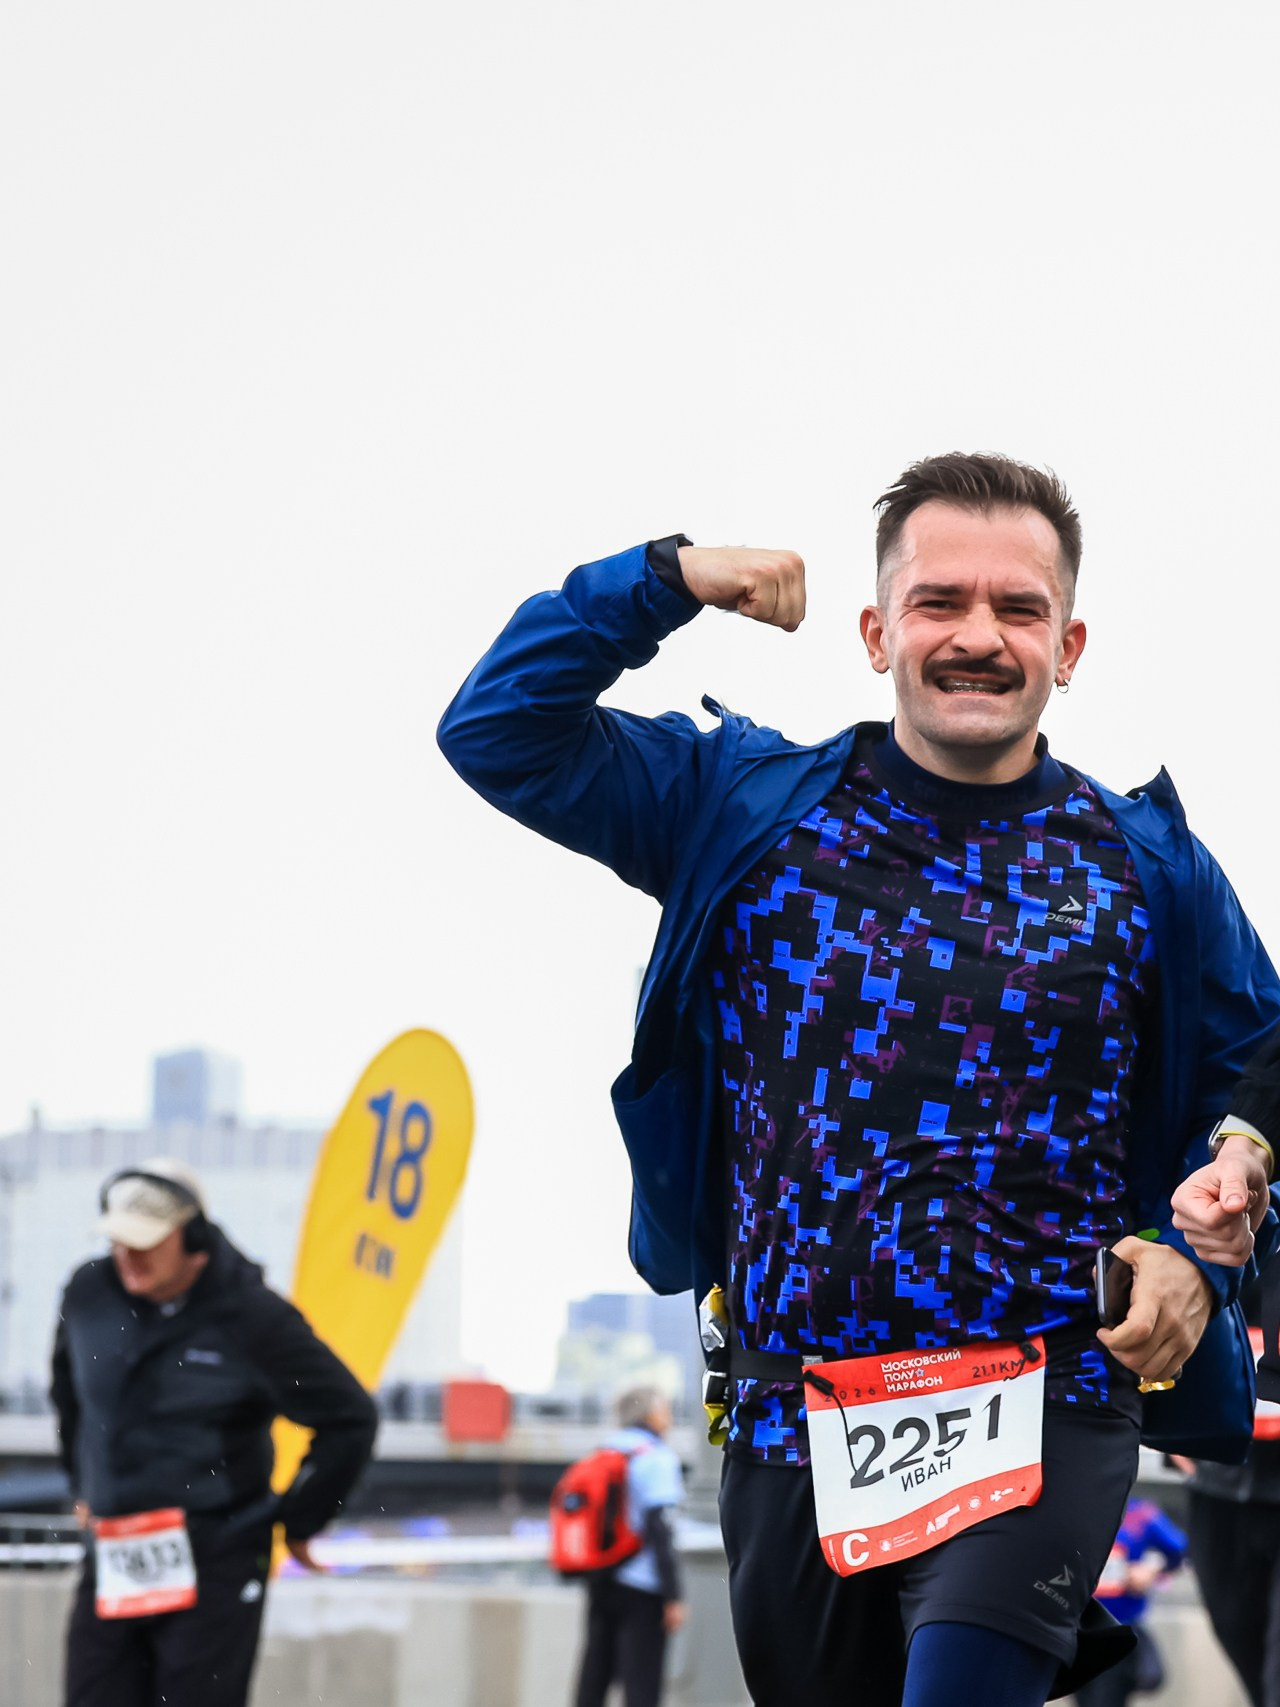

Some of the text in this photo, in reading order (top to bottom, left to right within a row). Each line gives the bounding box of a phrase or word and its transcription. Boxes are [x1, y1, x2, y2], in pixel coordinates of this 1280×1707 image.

[367, 1089, 433, 1220] 18
[880, 1348, 962, 1373] МОСКОВСКИЙ
[883, 1369, 915, 1383] ПОЛУ
[886, 1375, 944, 1393] МАРАФОН
[848, 1393, 1002, 1490] 2251
[900, 1456, 951, 1493] ИВАН
